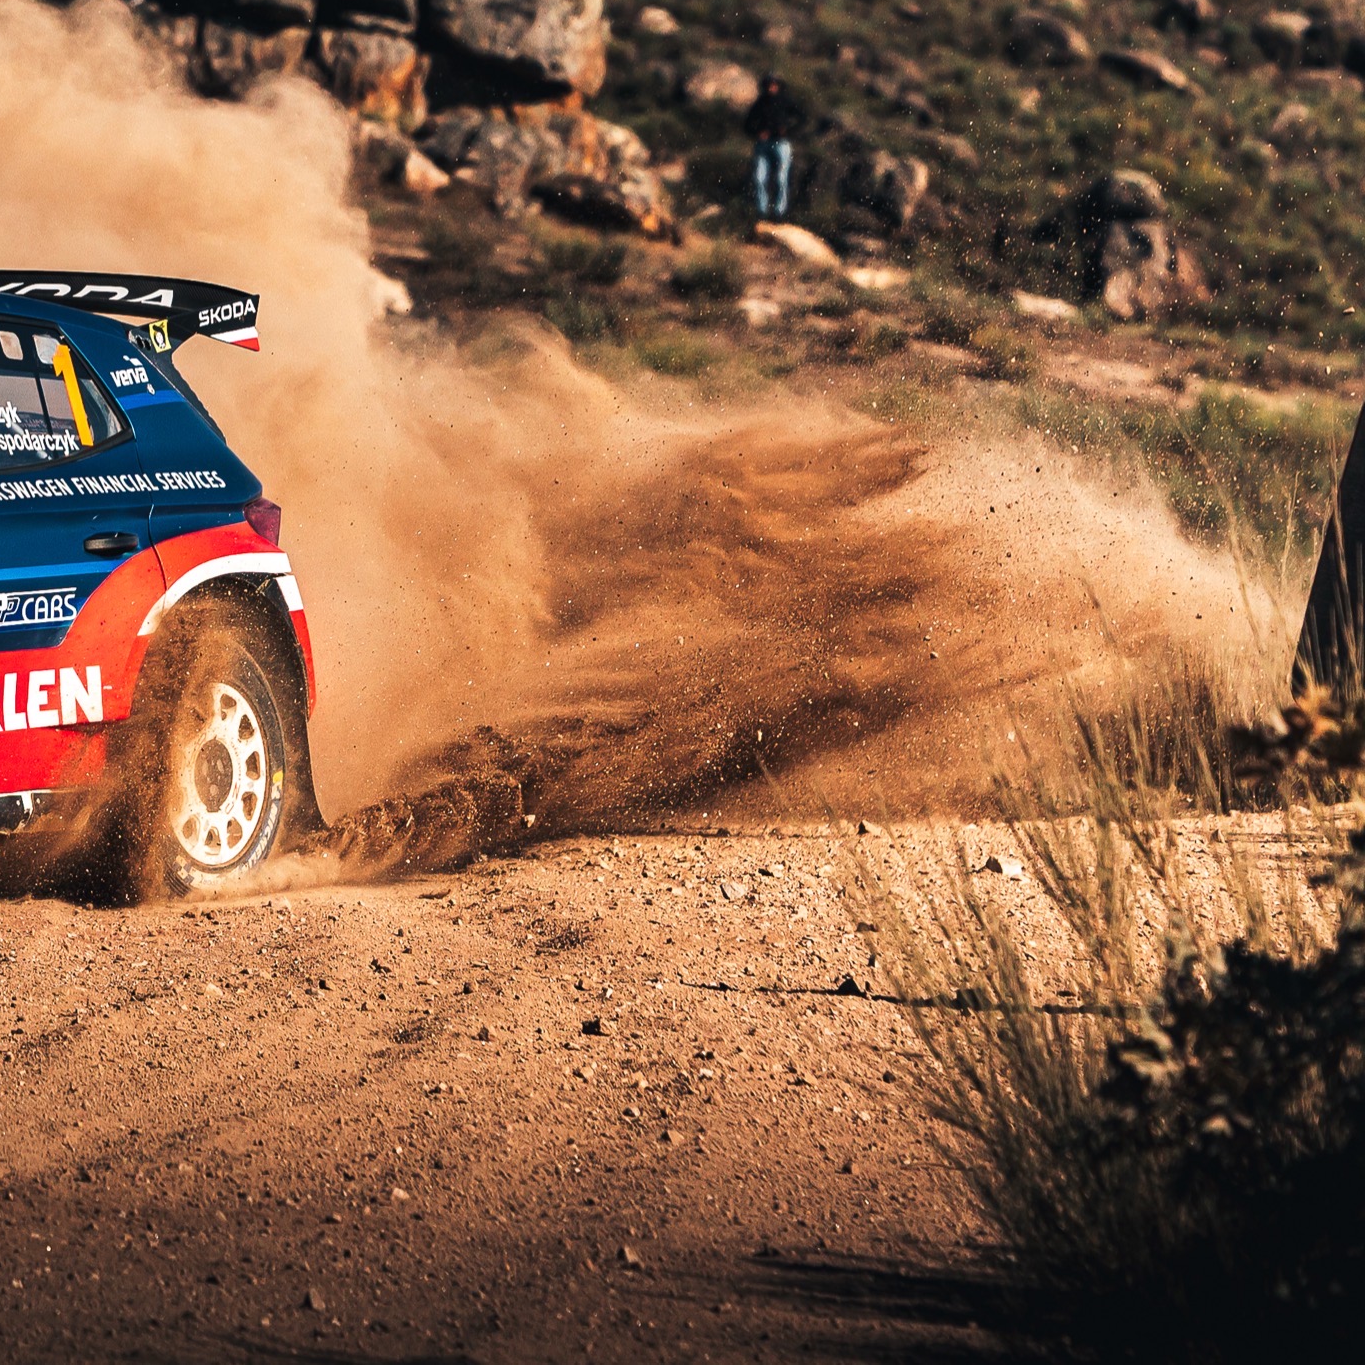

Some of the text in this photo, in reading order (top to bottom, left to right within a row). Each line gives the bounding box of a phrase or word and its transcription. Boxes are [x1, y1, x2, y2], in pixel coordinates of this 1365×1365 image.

[109, 366, 149, 388] verva
[52, 343, 94, 446] 1
[70, 473, 160, 495] FINANCIAL
[155, 470, 227, 490] SERVICES
[21, 593, 78, 622] CARS
